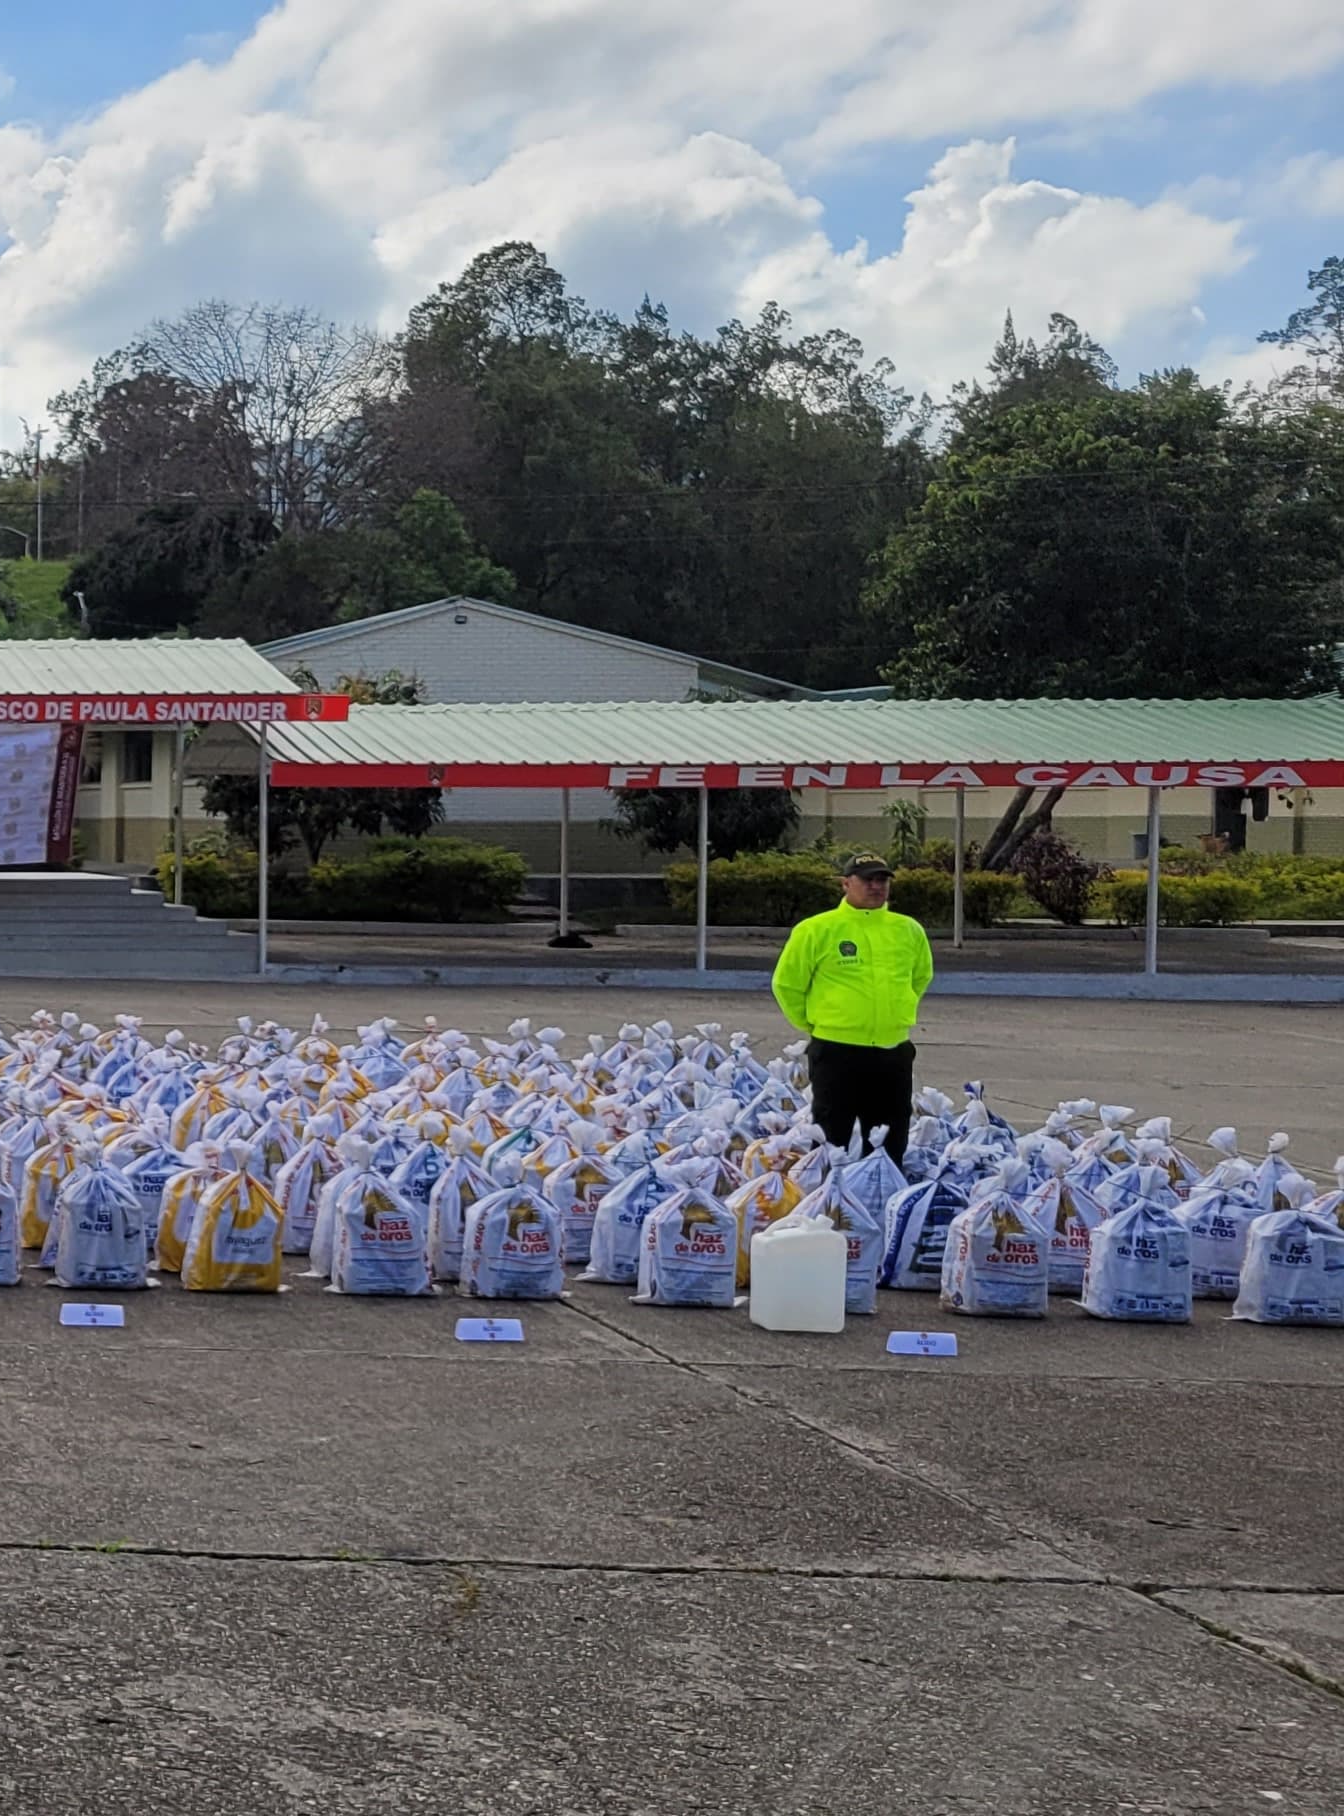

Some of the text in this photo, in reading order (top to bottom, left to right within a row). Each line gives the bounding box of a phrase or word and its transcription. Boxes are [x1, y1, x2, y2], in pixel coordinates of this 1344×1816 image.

[44, 702, 74, 721] DE
[79, 702, 149, 721] PAULA
[155, 702, 288, 721] SANTANDER
[608, 766, 1307, 787] FE EN LA CAUSA
[379, 1218, 409, 1231] haz
[1191, 1225, 1207, 1234] de
[360, 1231, 413, 1242] de oros
[521, 1230, 548, 1243] haz
[693, 1230, 722, 1244] haz
[1051, 1237, 1067, 1248] de
[502, 1241, 517, 1251] de
[674, 1243, 725, 1255] de oros
[1005, 1240, 1036, 1253] haz
[1117, 1246, 1132, 1256] de
[1004, 1253, 1039, 1265] oros
